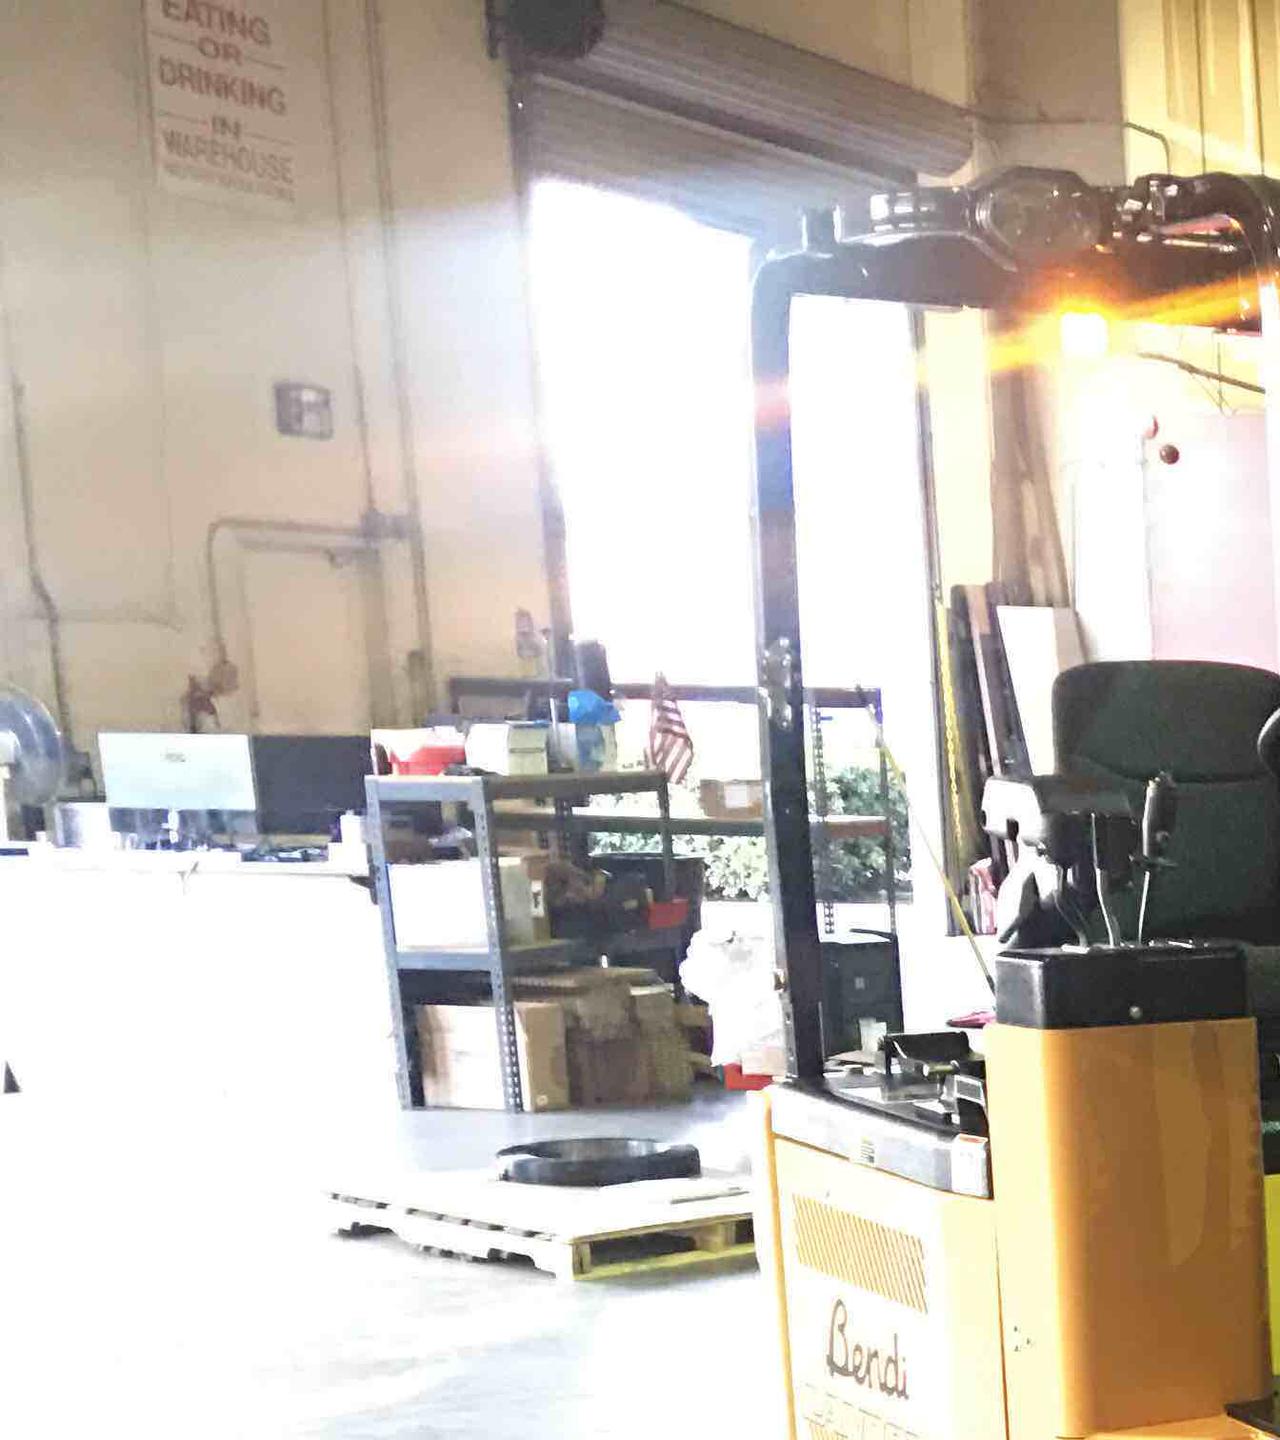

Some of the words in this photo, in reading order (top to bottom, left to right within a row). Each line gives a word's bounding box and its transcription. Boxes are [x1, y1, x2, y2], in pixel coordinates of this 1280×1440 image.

[162, 0, 271, 46] EATING
[198, 36, 243, 66] OR
[160, 56, 287, 116] DRINKING
[211, 115, 241, 140] IN
[163, 130, 294, 184] WAREHOUSE
[826, 1299, 909, 1400] Bendi
